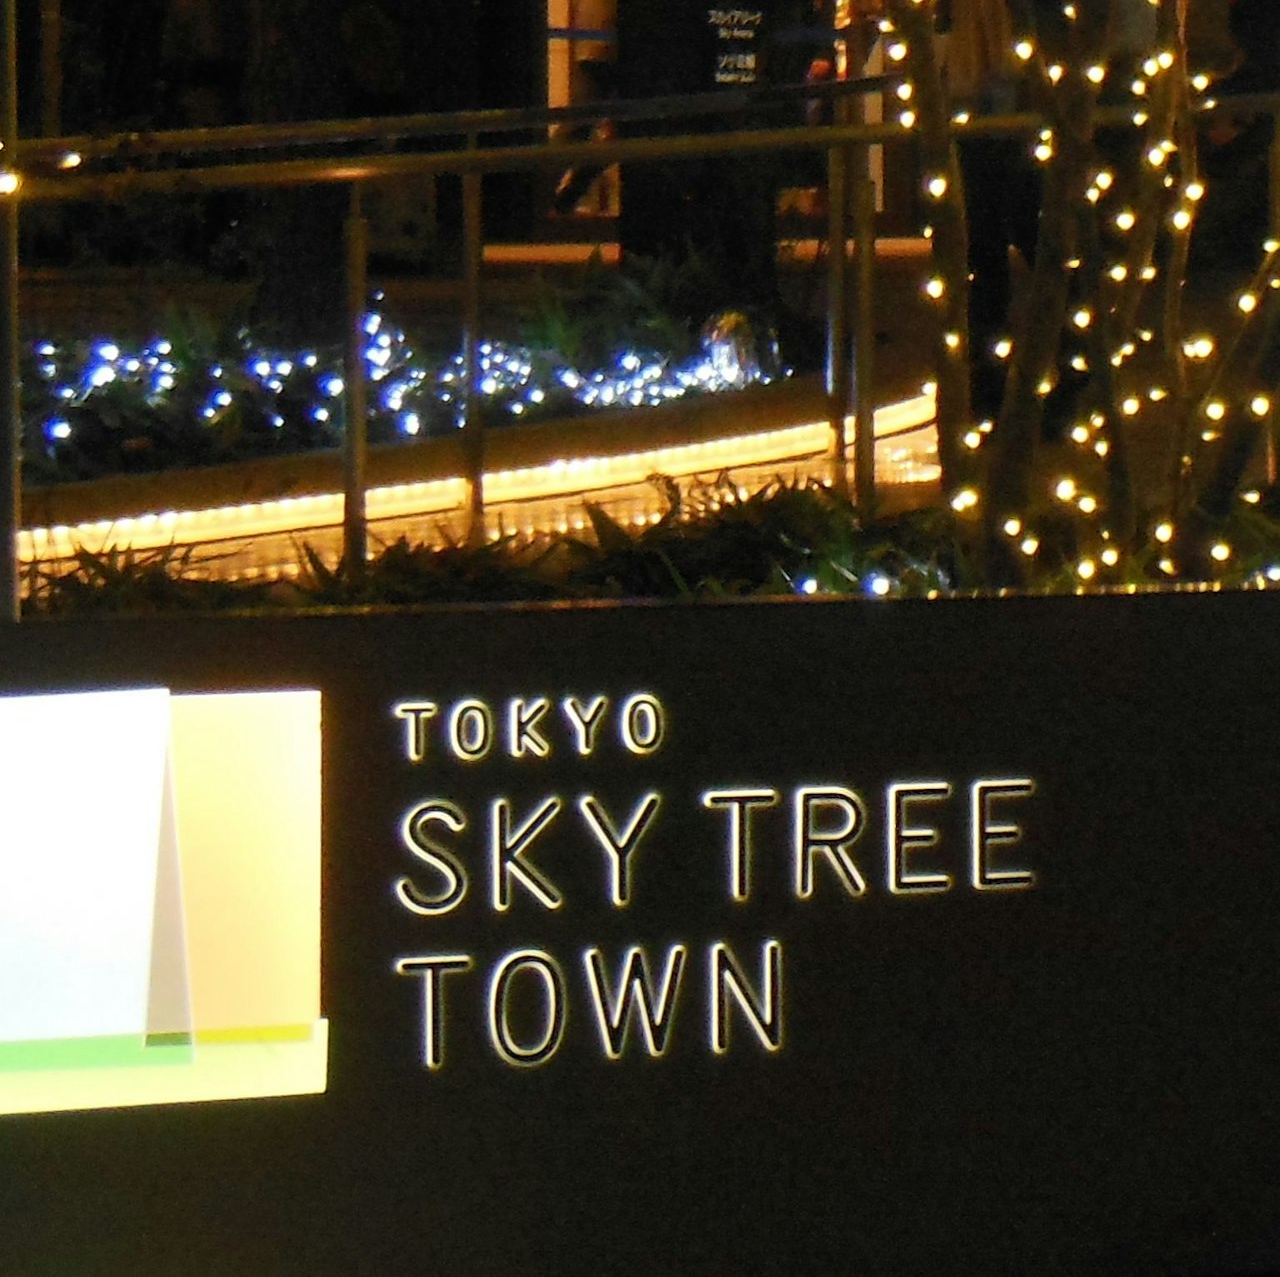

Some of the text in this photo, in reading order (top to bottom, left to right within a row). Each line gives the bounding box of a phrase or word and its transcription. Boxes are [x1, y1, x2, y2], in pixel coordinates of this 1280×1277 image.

[394, 692, 664, 763] TOKYO
[394, 778, 1034, 915] SKY TREE
[395, 939, 783, 1070] TOWN
